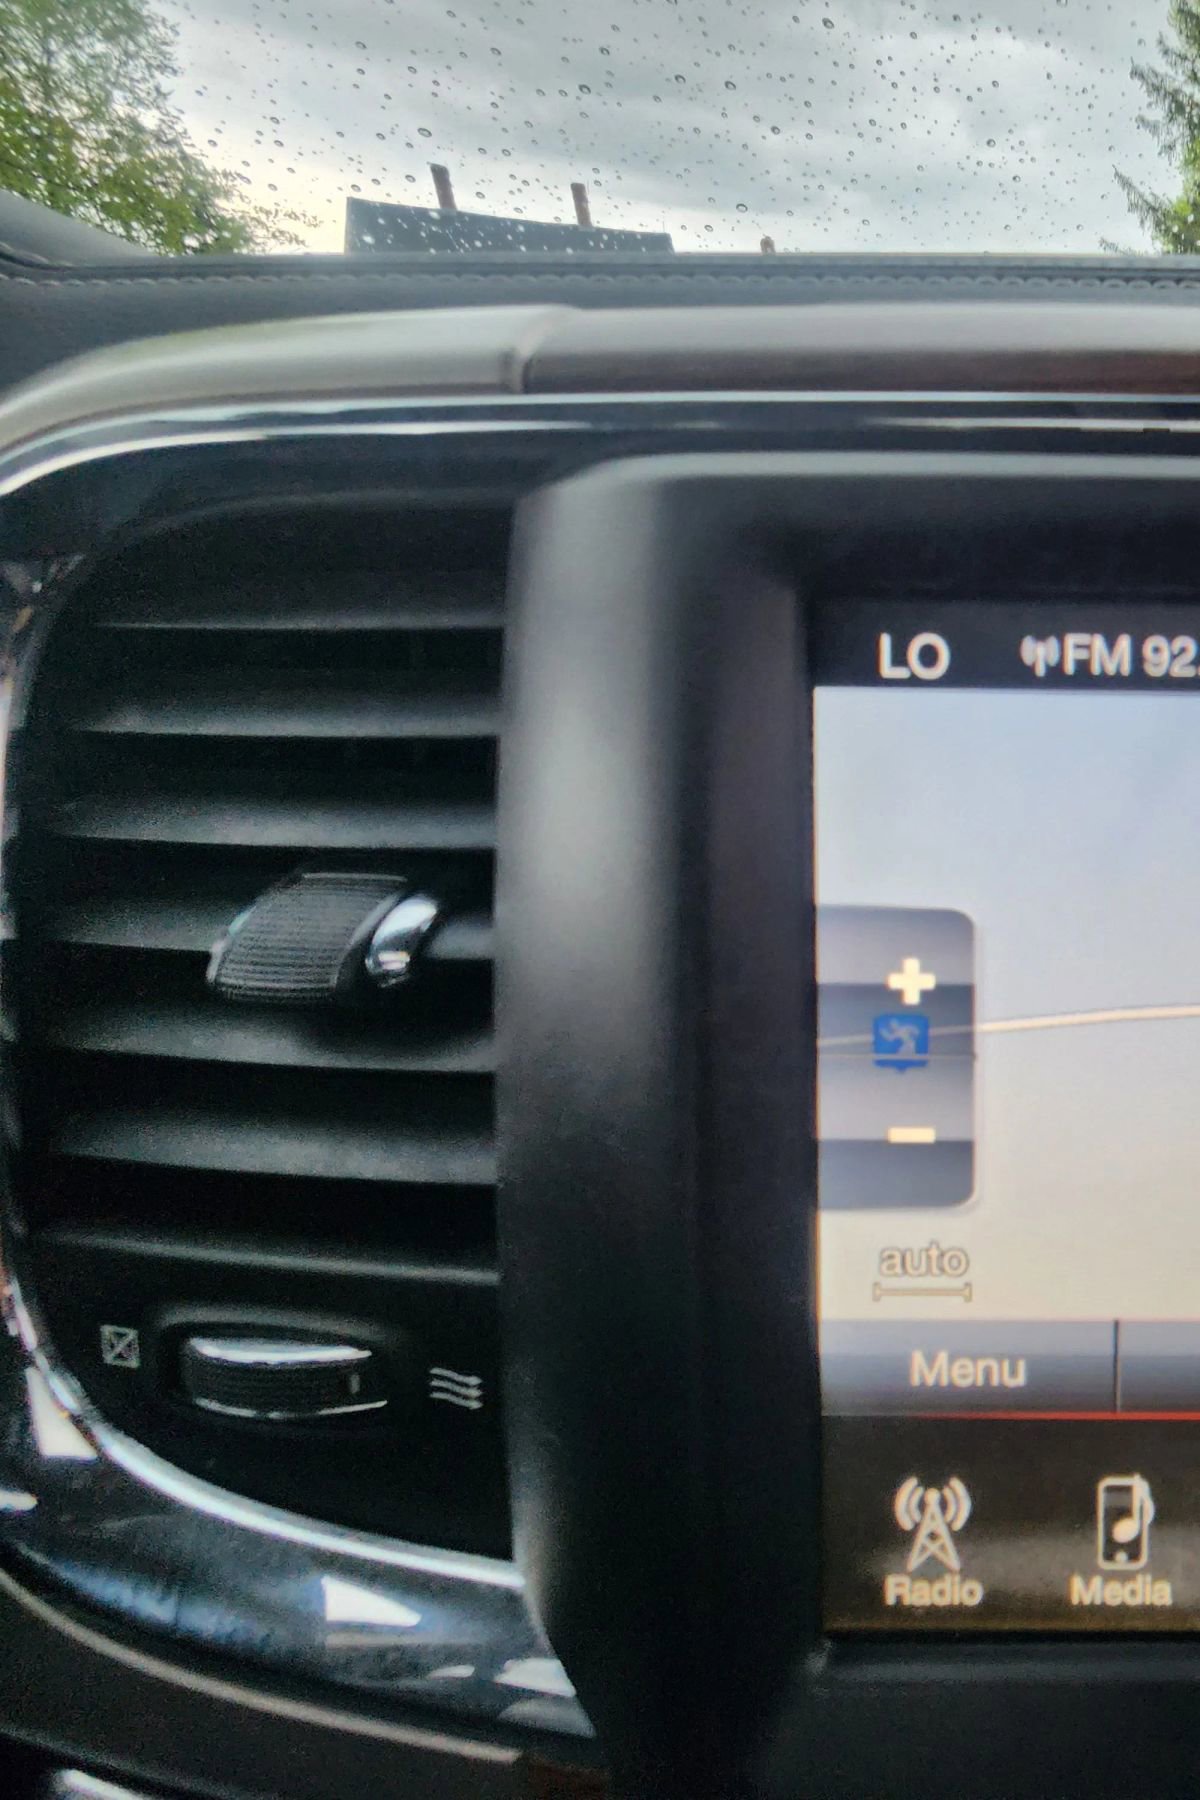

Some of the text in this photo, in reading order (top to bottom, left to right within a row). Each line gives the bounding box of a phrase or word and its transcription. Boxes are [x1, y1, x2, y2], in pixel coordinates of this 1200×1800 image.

[877, 632, 951, 680] LO
[1062, 633, 1133, 678] FM
[879, 1240, 970, 1277] auto
[909, 1350, 1027, 1389] Menu
[884, 1574, 984, 1607] Radio
[1070, 1575, 1174, 1607] Media
